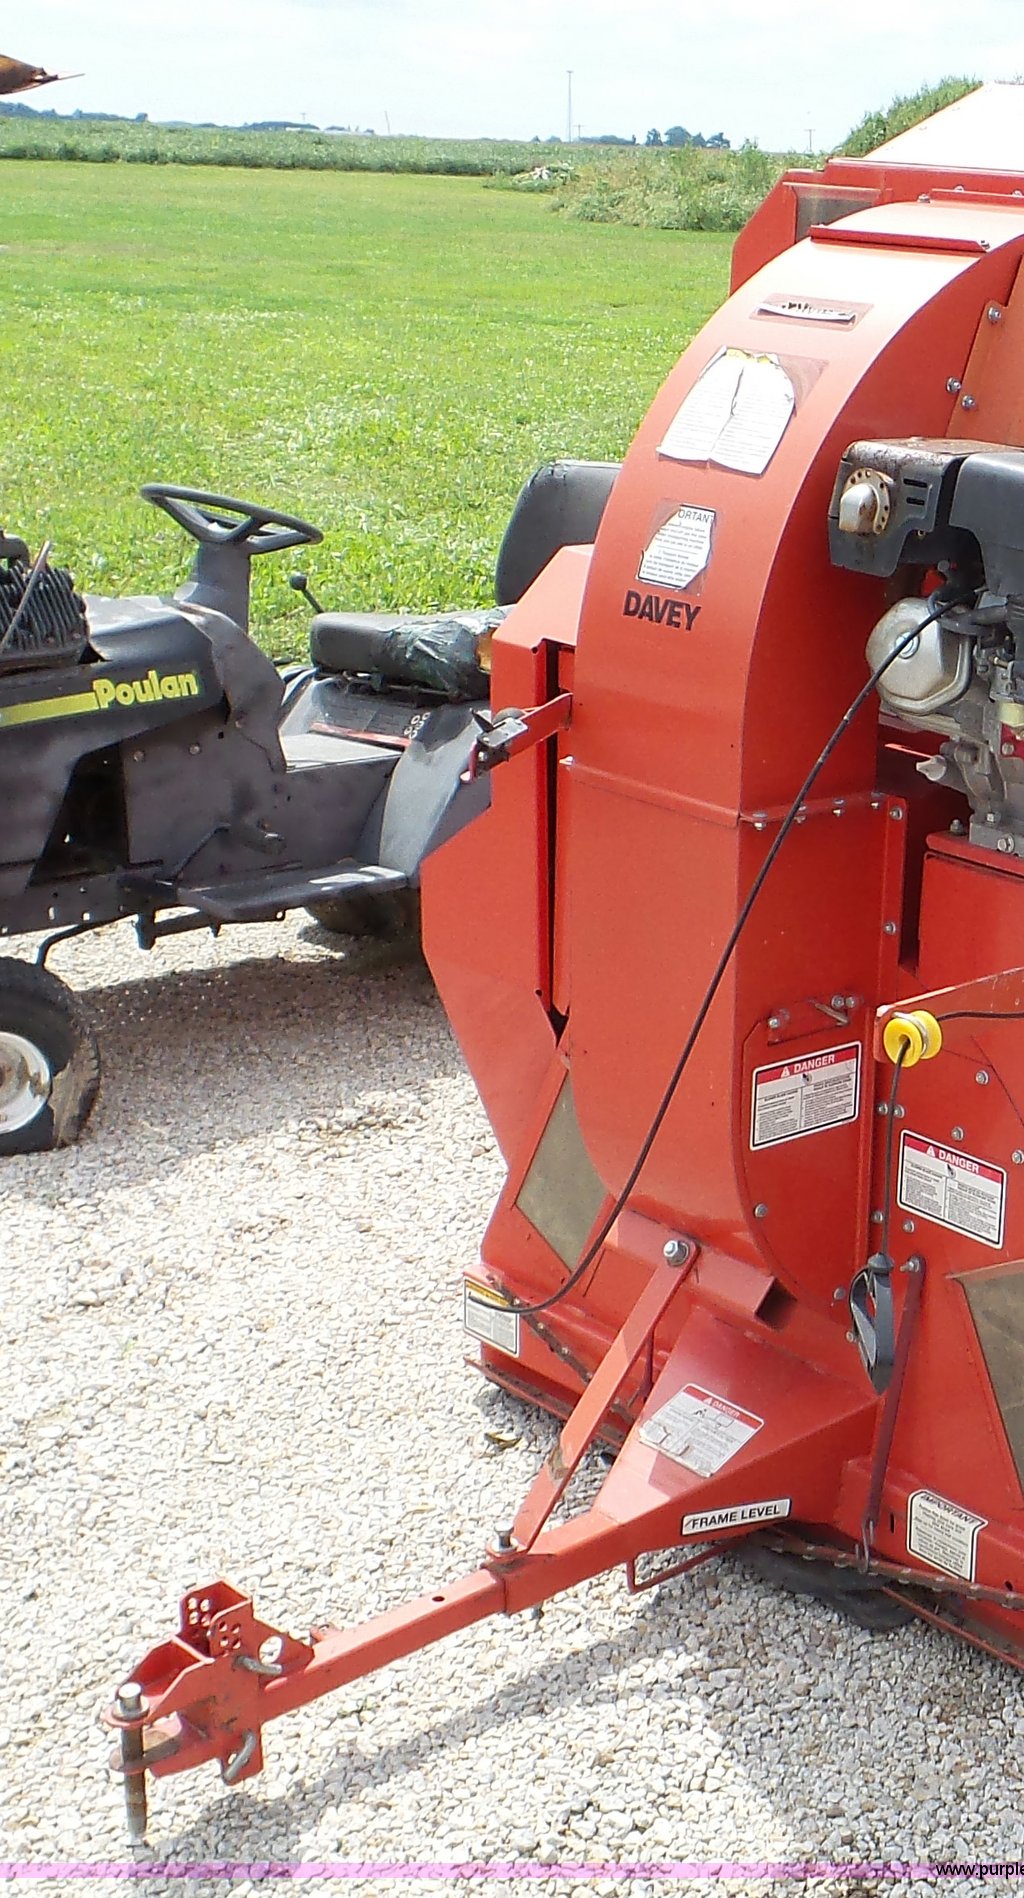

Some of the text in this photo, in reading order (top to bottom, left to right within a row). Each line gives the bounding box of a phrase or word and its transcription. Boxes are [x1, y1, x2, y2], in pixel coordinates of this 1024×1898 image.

[624, 591, 701, 631] DAVEY
[93, 670, 198, 709] Poulan
[793, 1054, 835, 1073] DANGER
[938, 1149, 979, 1174] DANGER
[691, 1504, 780, 1529] FRAME LEVEL
